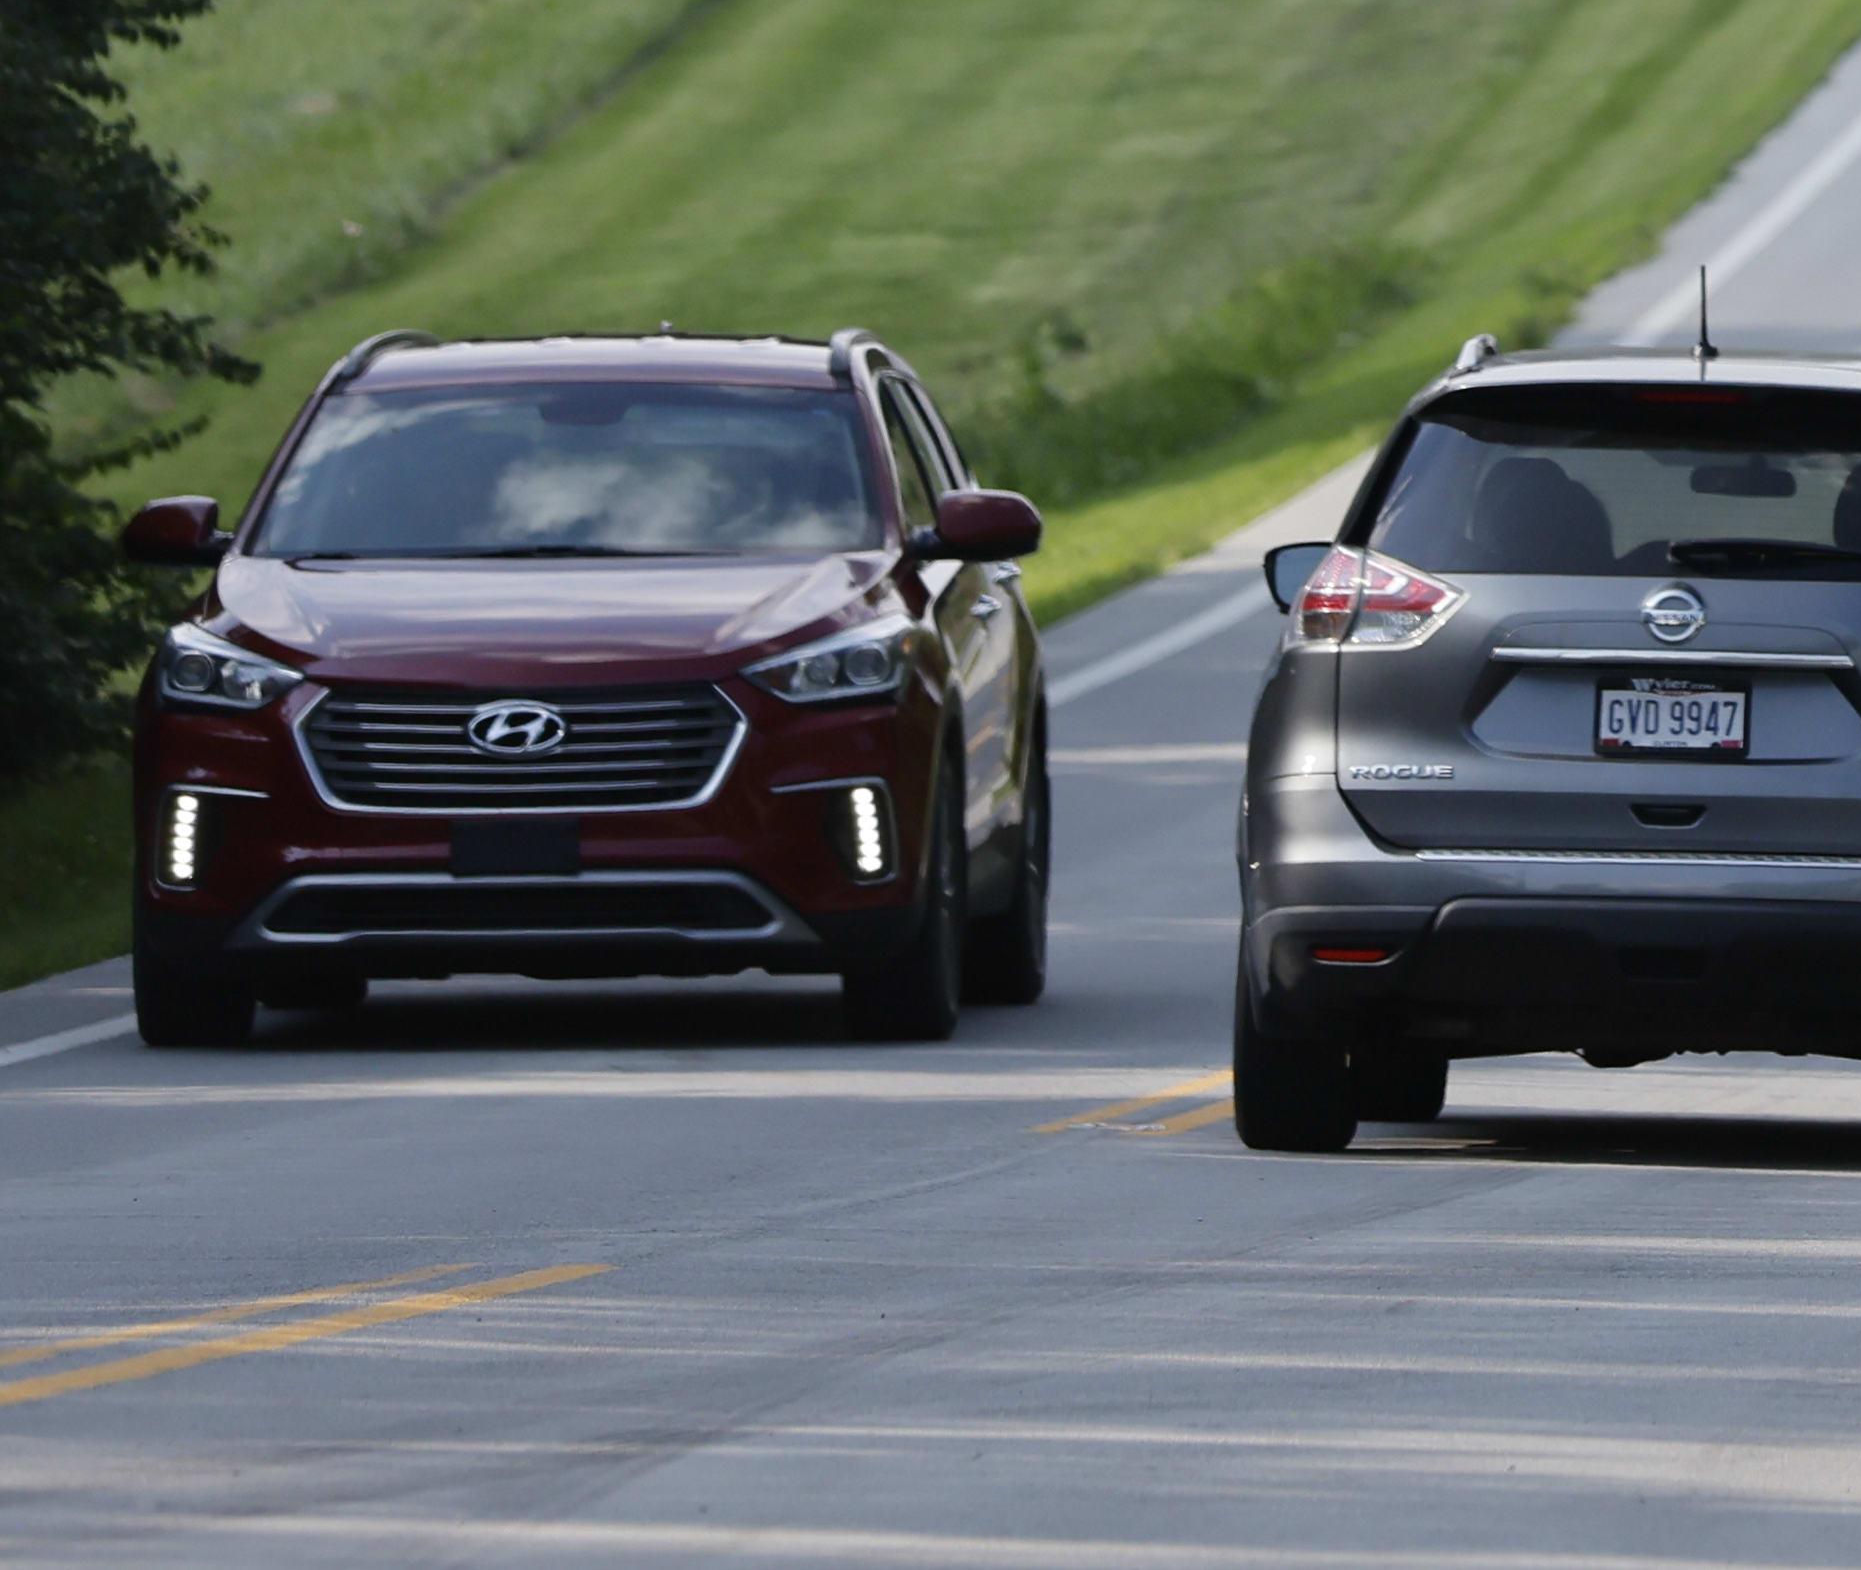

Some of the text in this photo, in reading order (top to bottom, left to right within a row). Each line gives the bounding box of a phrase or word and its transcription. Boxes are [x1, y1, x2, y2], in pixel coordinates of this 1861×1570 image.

[1608, 698, 1739, 737] GVD 9947
[1348, 763, 1455, 780] ROGUE
